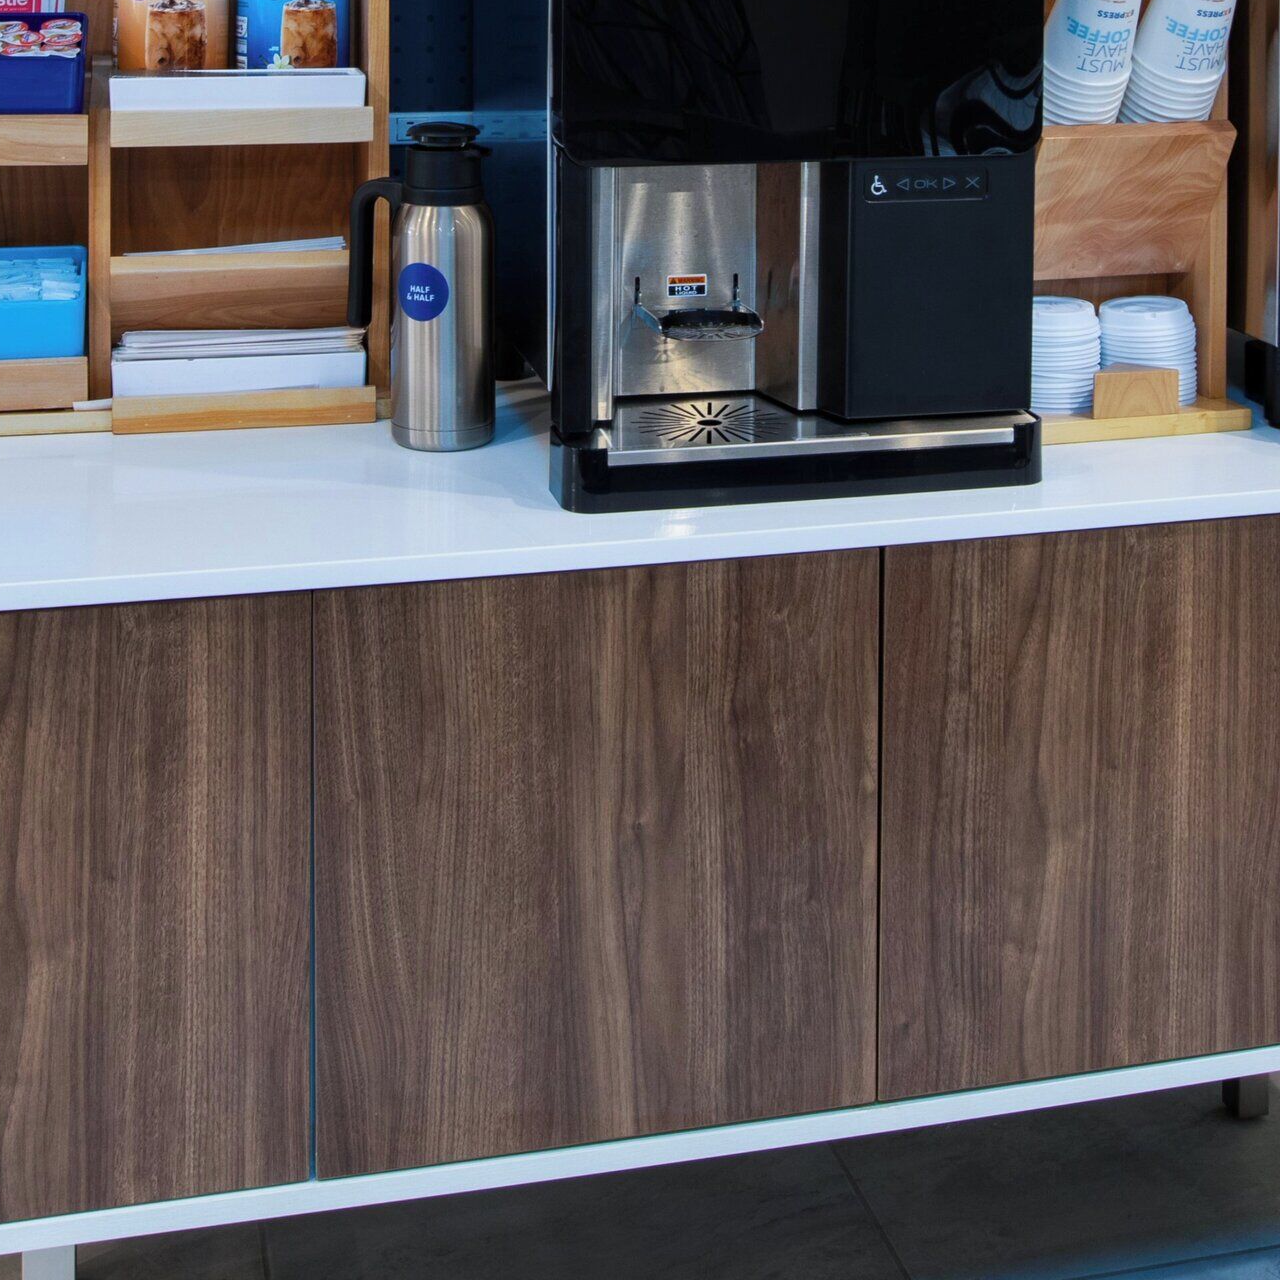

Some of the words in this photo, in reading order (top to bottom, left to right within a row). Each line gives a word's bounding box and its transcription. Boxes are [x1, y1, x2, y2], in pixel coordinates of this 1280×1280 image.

[1067, 16, 1131, 44] COFFEE.
[1165, 15, 1228, 42] COFFEE.
[1082, 40, 1128, 58] HAVE.
[1182, 39, 1225, 56] HAVE.
[1076, 55, 1125, 73] MUST.
[1175, 54, 1221, 71] MUST.
[914, 179, 938, 189] OK
[410, 285, 430, 293] HALF
[413, 293, 435, 301] HALF
